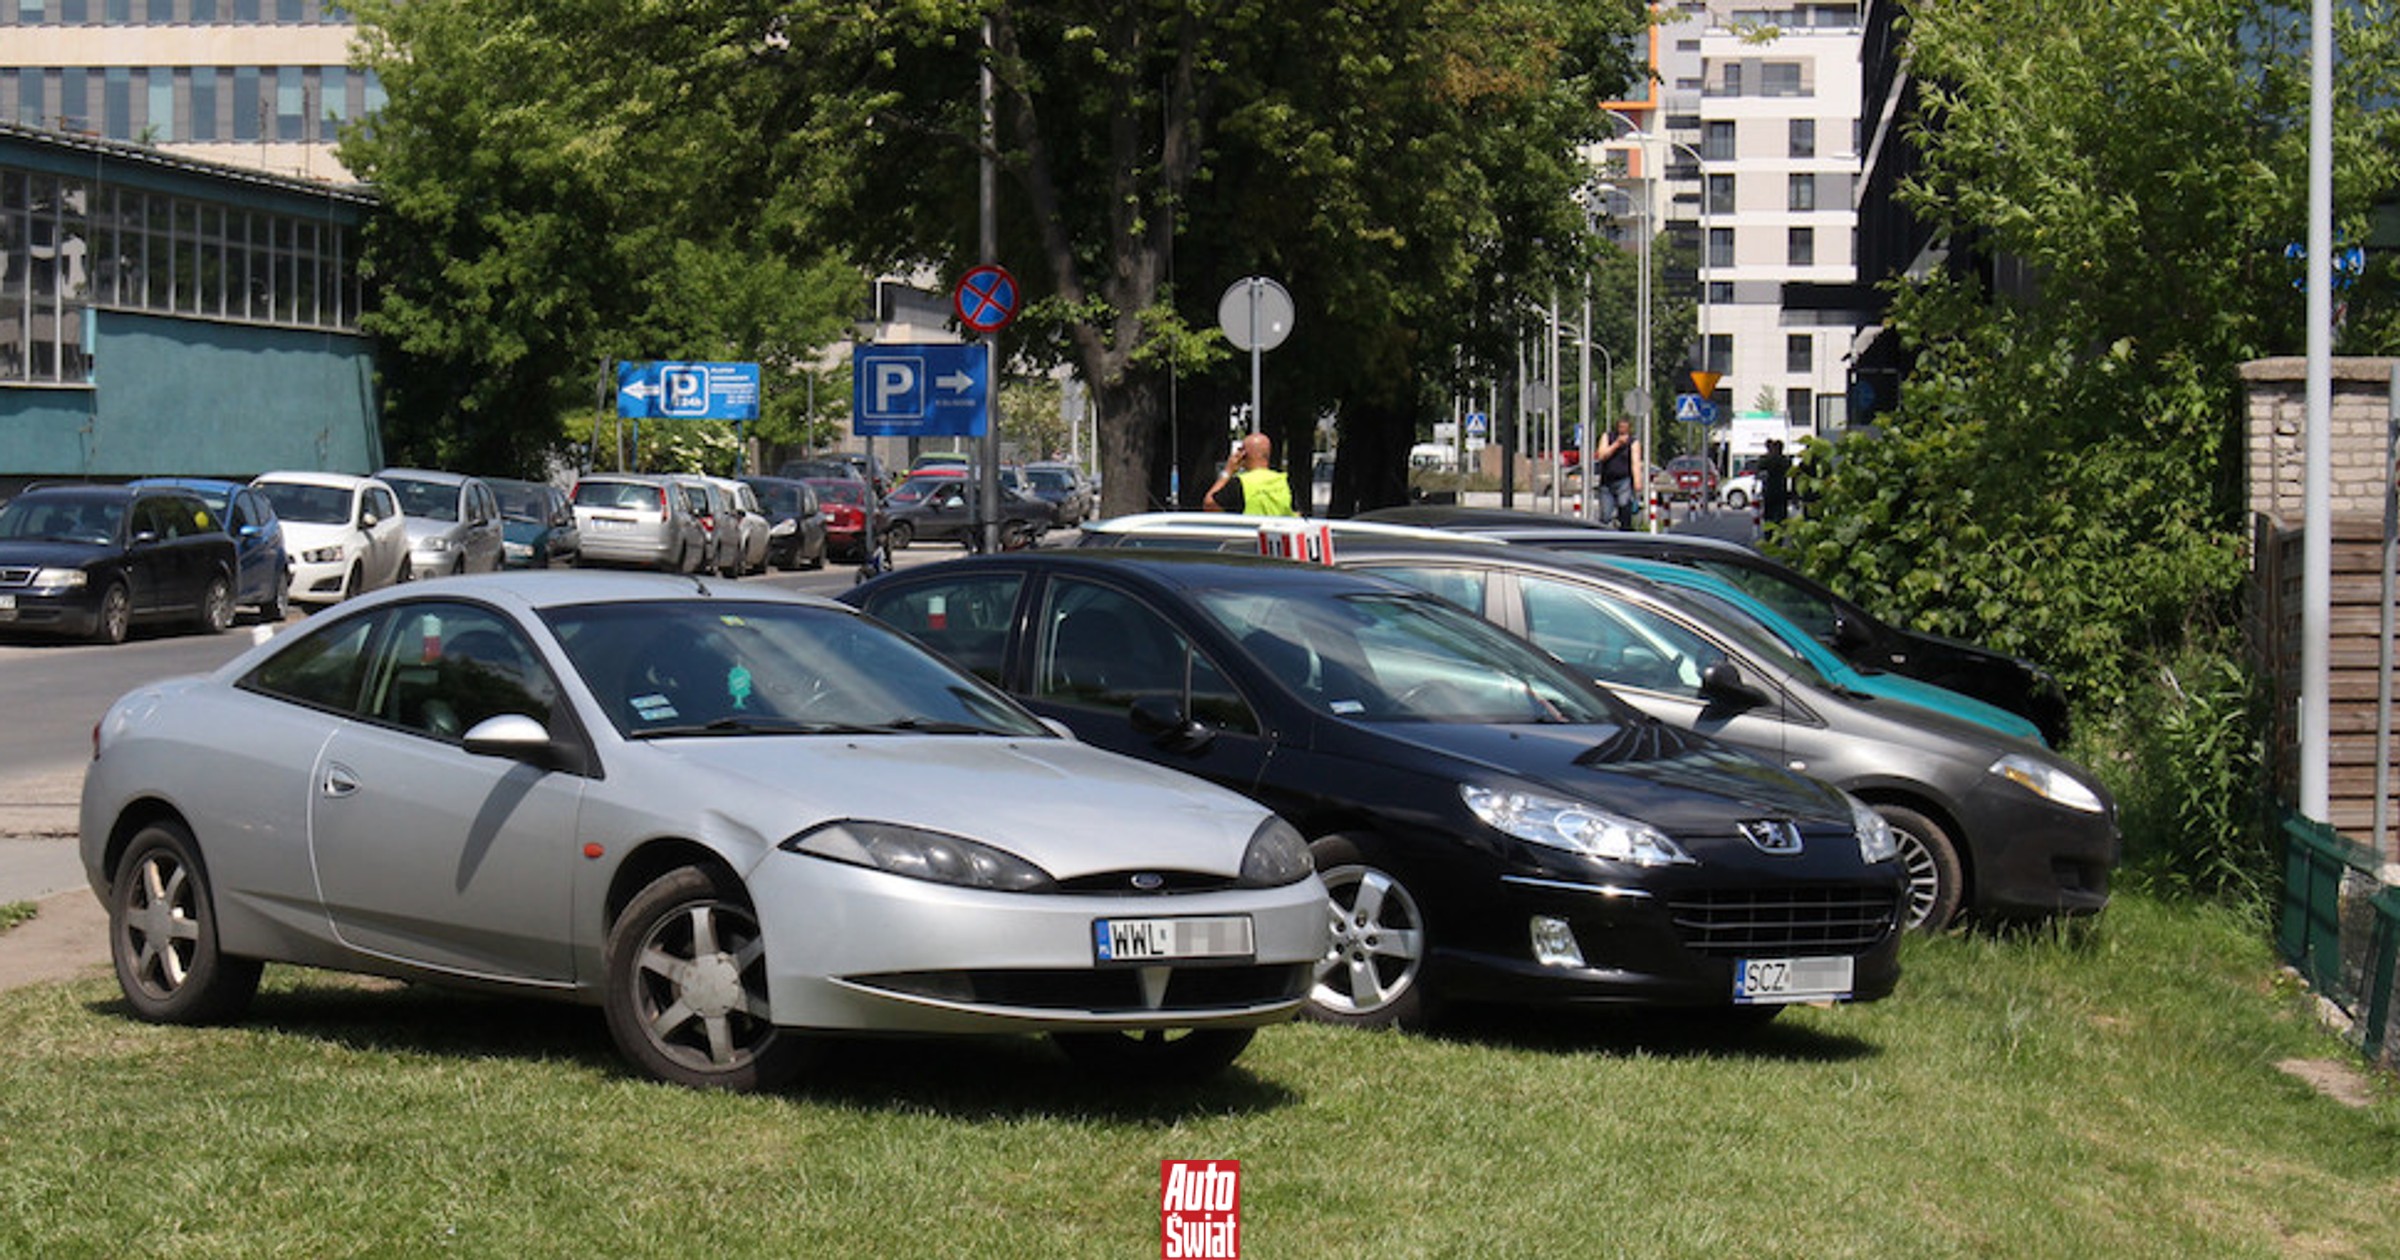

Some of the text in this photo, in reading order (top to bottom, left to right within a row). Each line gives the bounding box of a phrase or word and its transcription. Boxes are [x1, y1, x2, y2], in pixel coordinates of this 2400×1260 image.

[671, 373, 698, 406] P
[876, 363, 914, 411] P
[1112, 923, 1164, 955] WWL
[1746, 963, 1786, 992] SCZ
